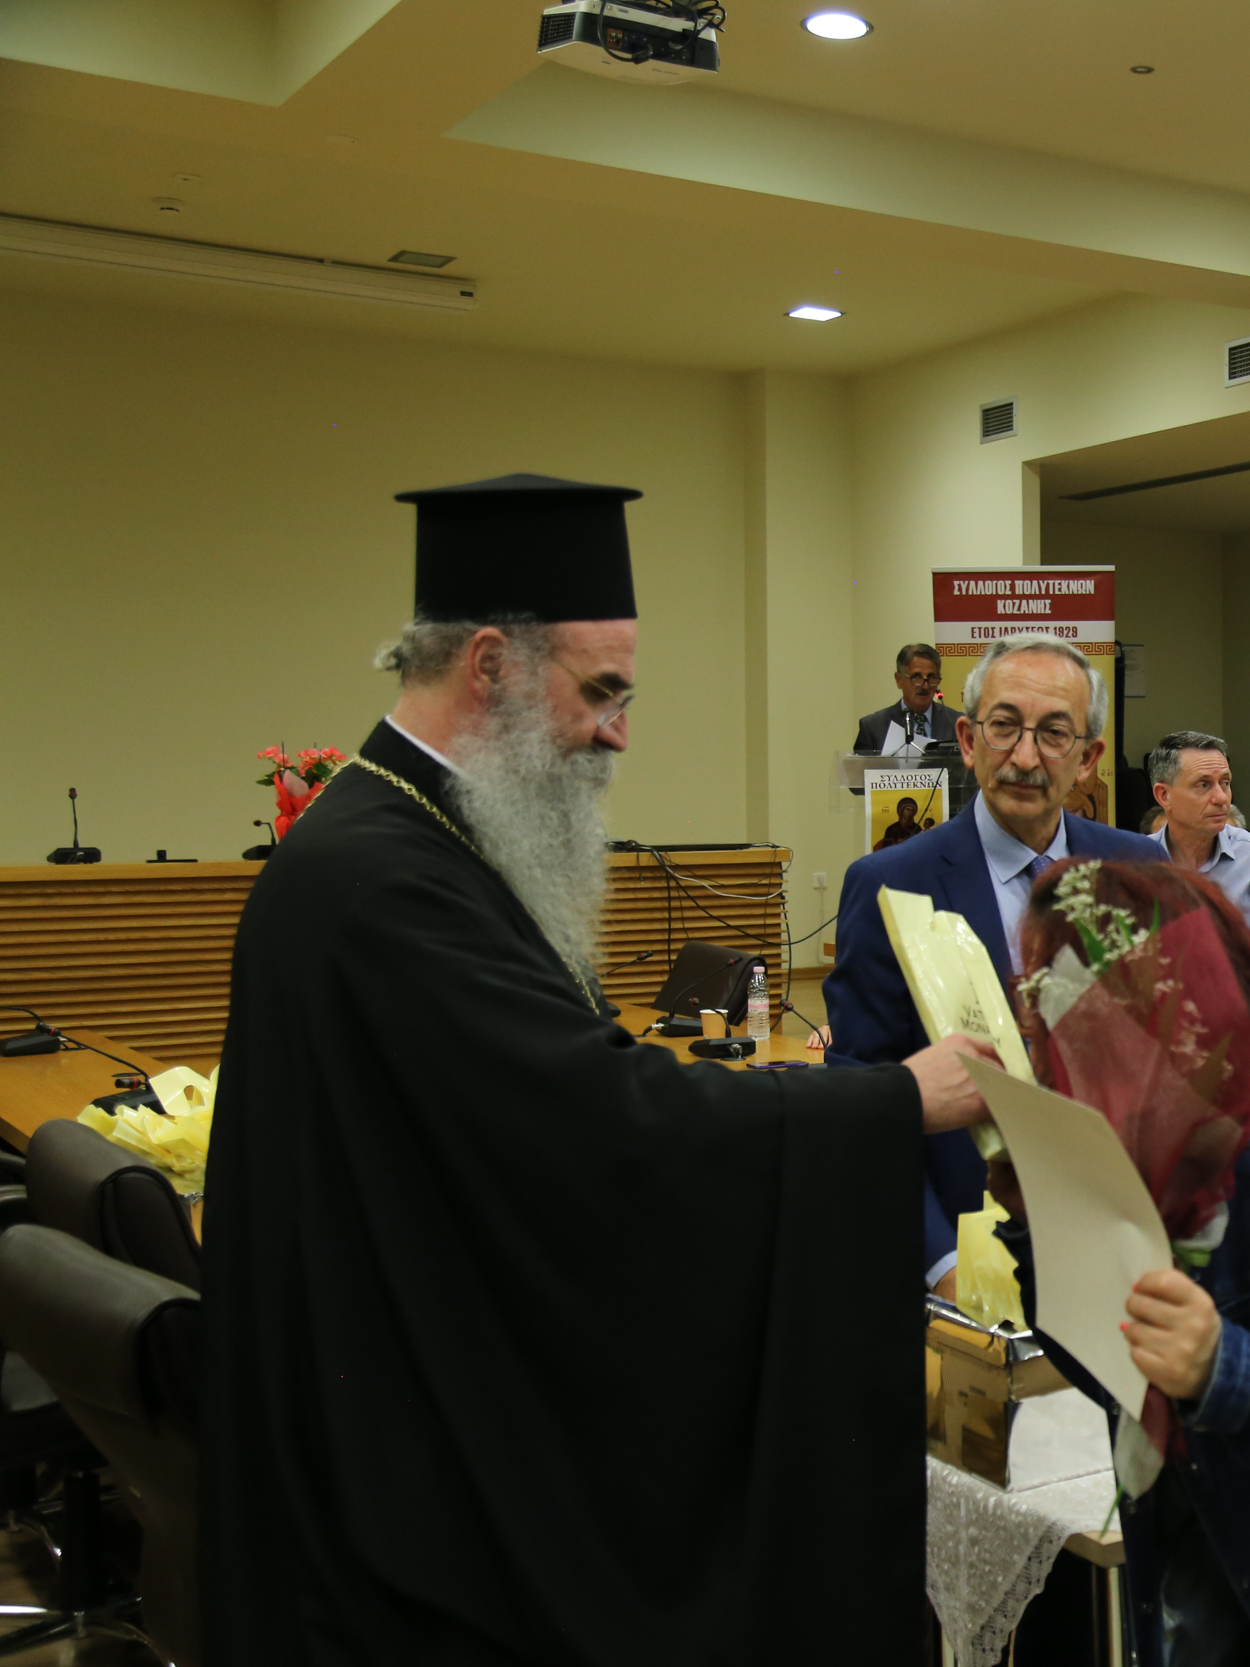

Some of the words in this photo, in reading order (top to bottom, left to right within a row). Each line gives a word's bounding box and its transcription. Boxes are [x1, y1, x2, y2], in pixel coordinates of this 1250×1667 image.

[953, 580, 1012, 595] ΣΥΛΛΟΓΟΣ
[1015, 579, 1095, 595] ΠΟΛΥΤΕΚΝΩΝ
[997, 599, 1052, 614] ΚΟΖΑΝΗΣ
[971, 626, 996, 639] ΕΤΟΣ
[1053, 626, 1078, 638] 1929
[880, 774, 933, 782] ΣΥΛΛΟΓΟΣ
[871, 781, 942, 790] ΠΟΛΥΤΕΚΝΩΝ
